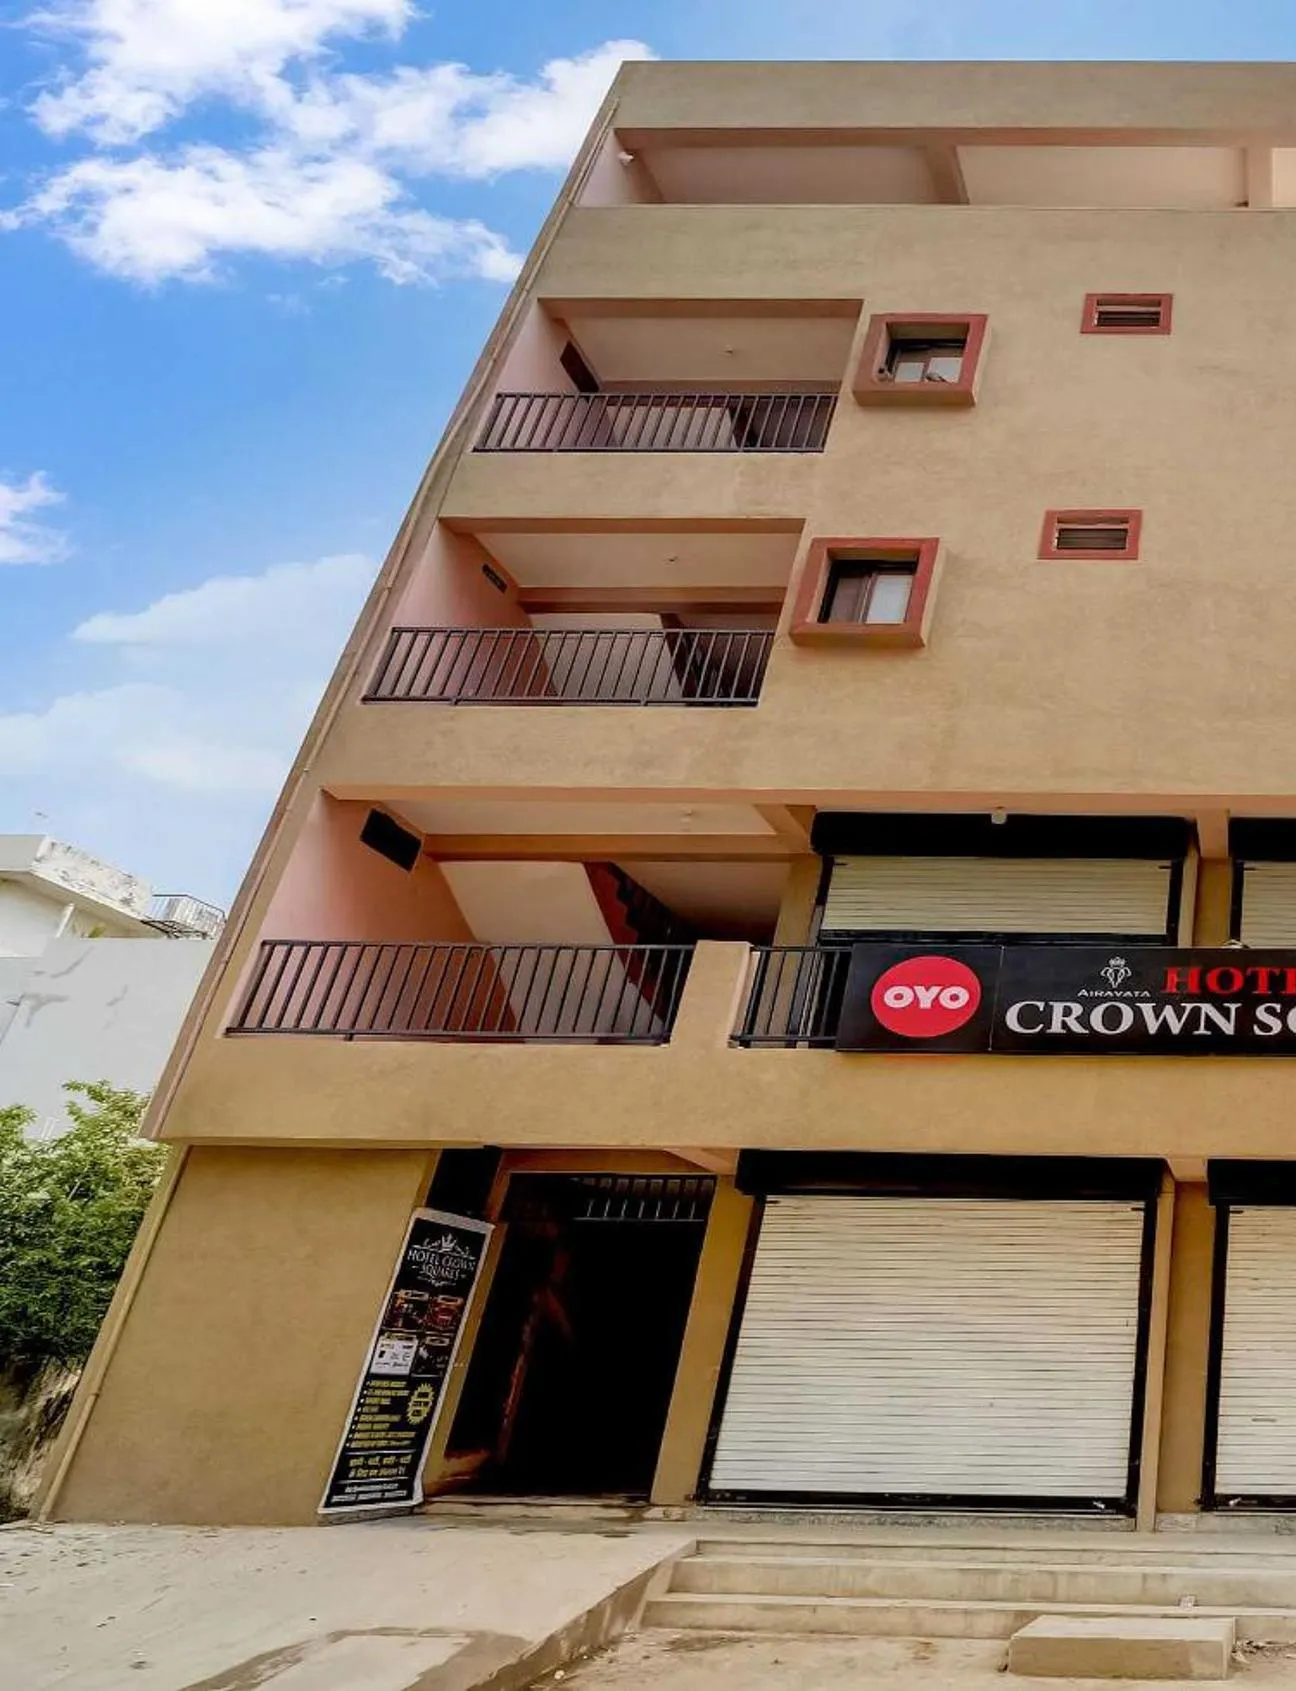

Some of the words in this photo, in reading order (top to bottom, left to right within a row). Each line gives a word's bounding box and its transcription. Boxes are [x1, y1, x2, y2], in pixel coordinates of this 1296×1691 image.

[883, 985, 970, 1009] OYO
[1077, 988, 1151, 998] AIRAVATA
[1005, 1000, 1242, 1036] CROWN
[407, 1249, 439, 1265] HOTEL
